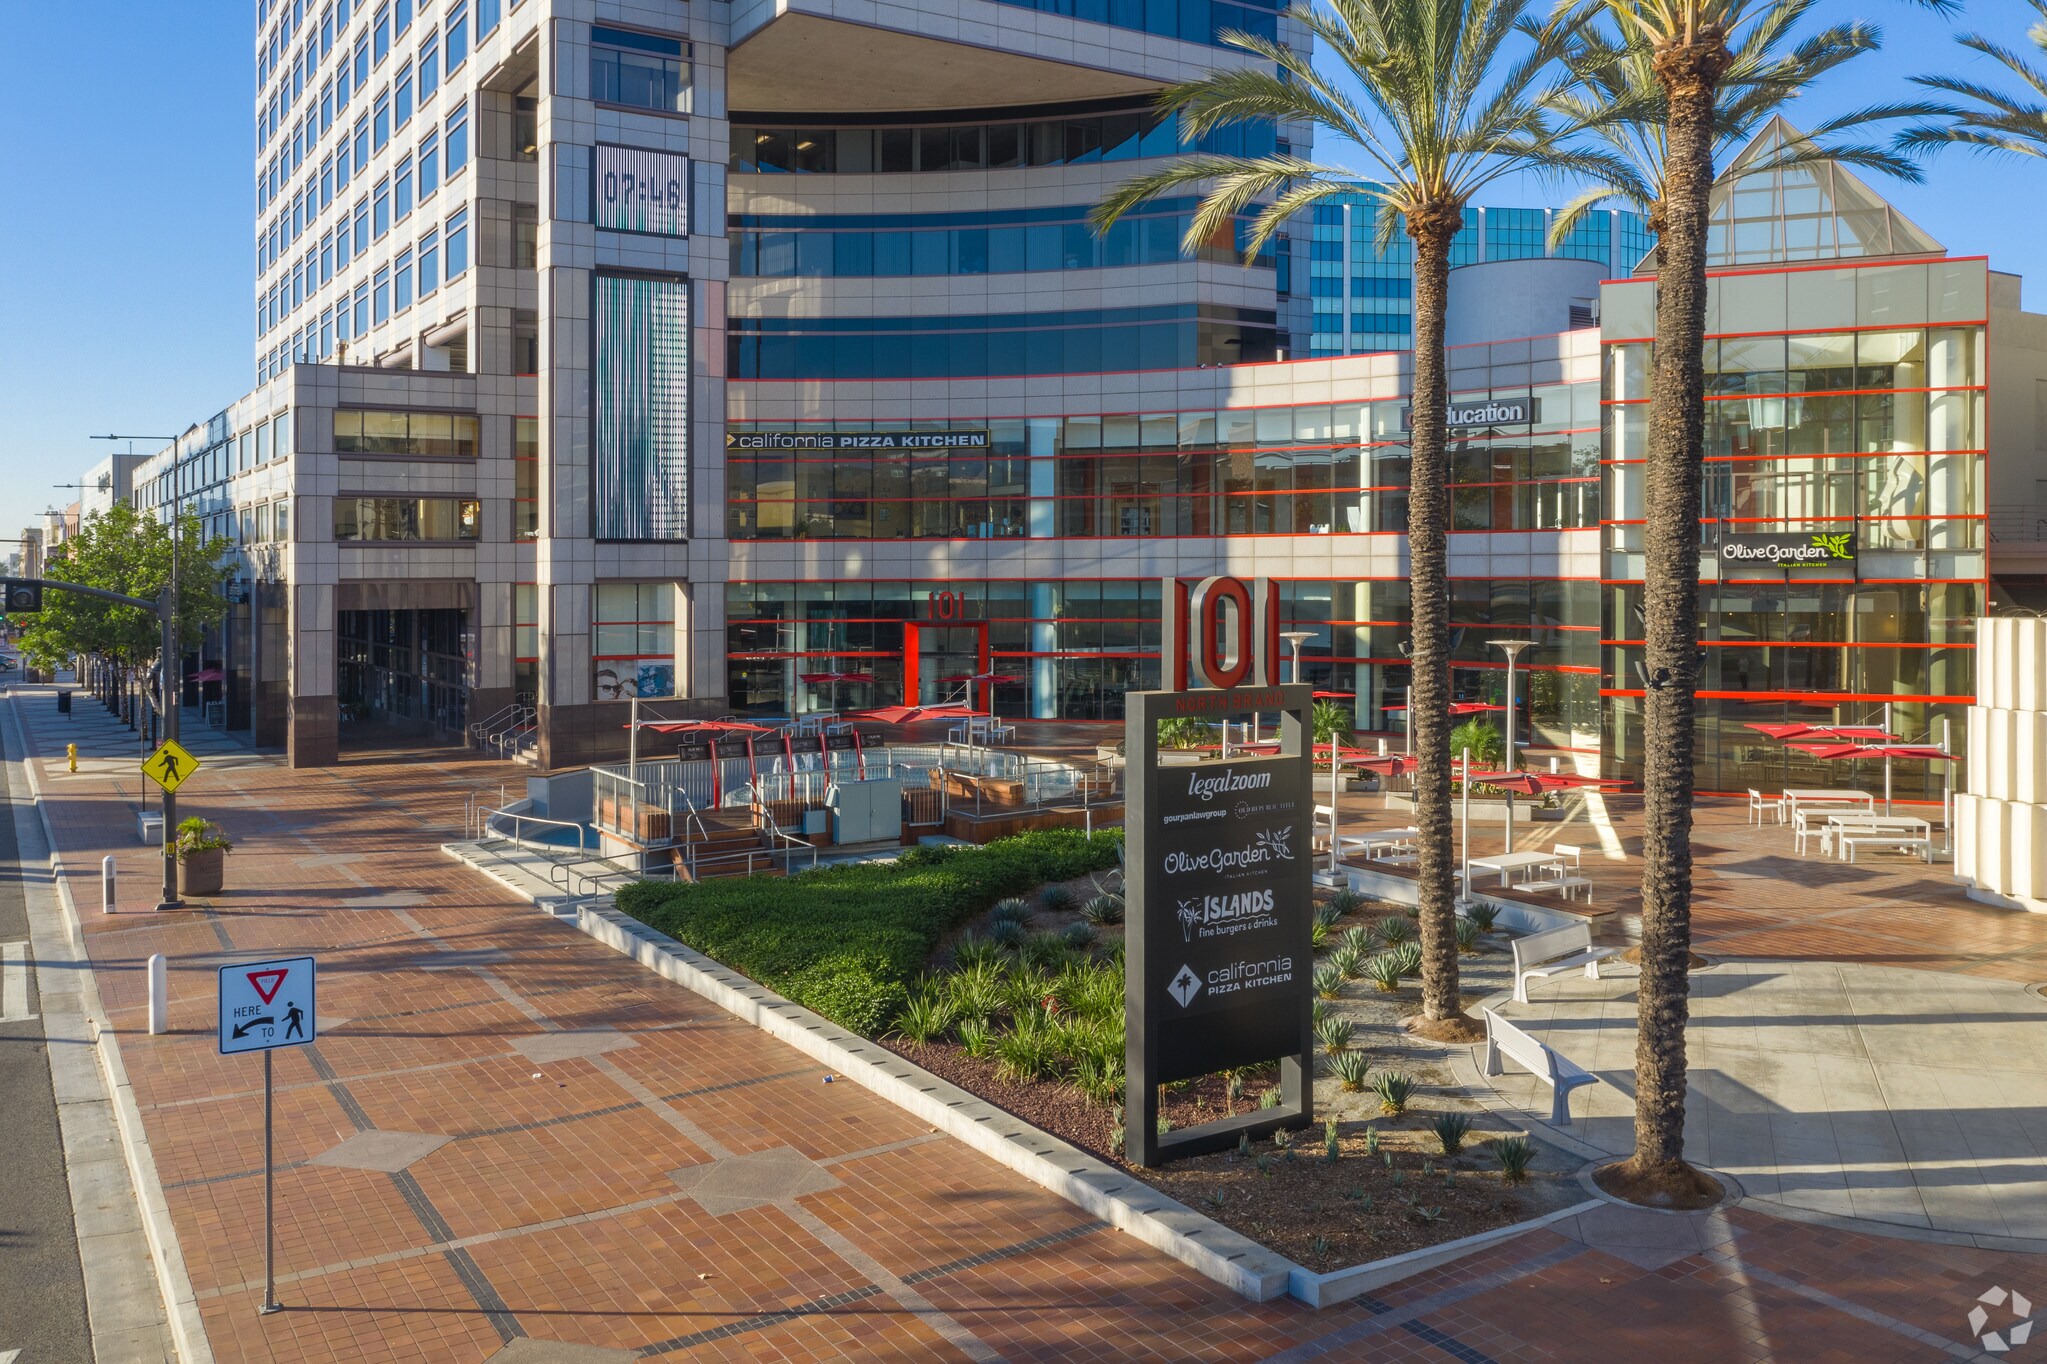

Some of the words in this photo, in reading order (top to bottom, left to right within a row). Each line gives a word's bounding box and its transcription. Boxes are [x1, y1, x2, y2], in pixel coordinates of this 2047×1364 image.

[1446, 403, 1523, 425] ucation
[739, 433, 834, 448] california
[840, 436, 895, 447] PIZZA
[901, 435, 984, 447] KITCHEN
[1723, 543, 1765, 559] Olive
[1766, 544, 1828, 562] Garden
[928, 591, 964, 619] 101
[1162, 576, 1280, 692] 101
[1176, 695, 1227, 713] NORTH
[1233, 690, 1285, 709] BRAND
[1188, 768, 1271, 801] legalzoom
[1164, 851, 1209, 874] Olive
[1209, 844, 1271, 873] Garden
[1203, 889, 1274, 924] ISLANDS
[1199, 927, 1215, 938] fine
[1216, 924, 1247, 936] burgers
[1253, 917, 1278, 929] drinks
[1208, 955, 1292, 984] california
[1208, 982, 1241, 996] PIZZA
[1244, 973, 1292, 989] KITCHEN
[233, 1005, 262, 1018] HERE
[261, 1027, 275, 1038] TO
